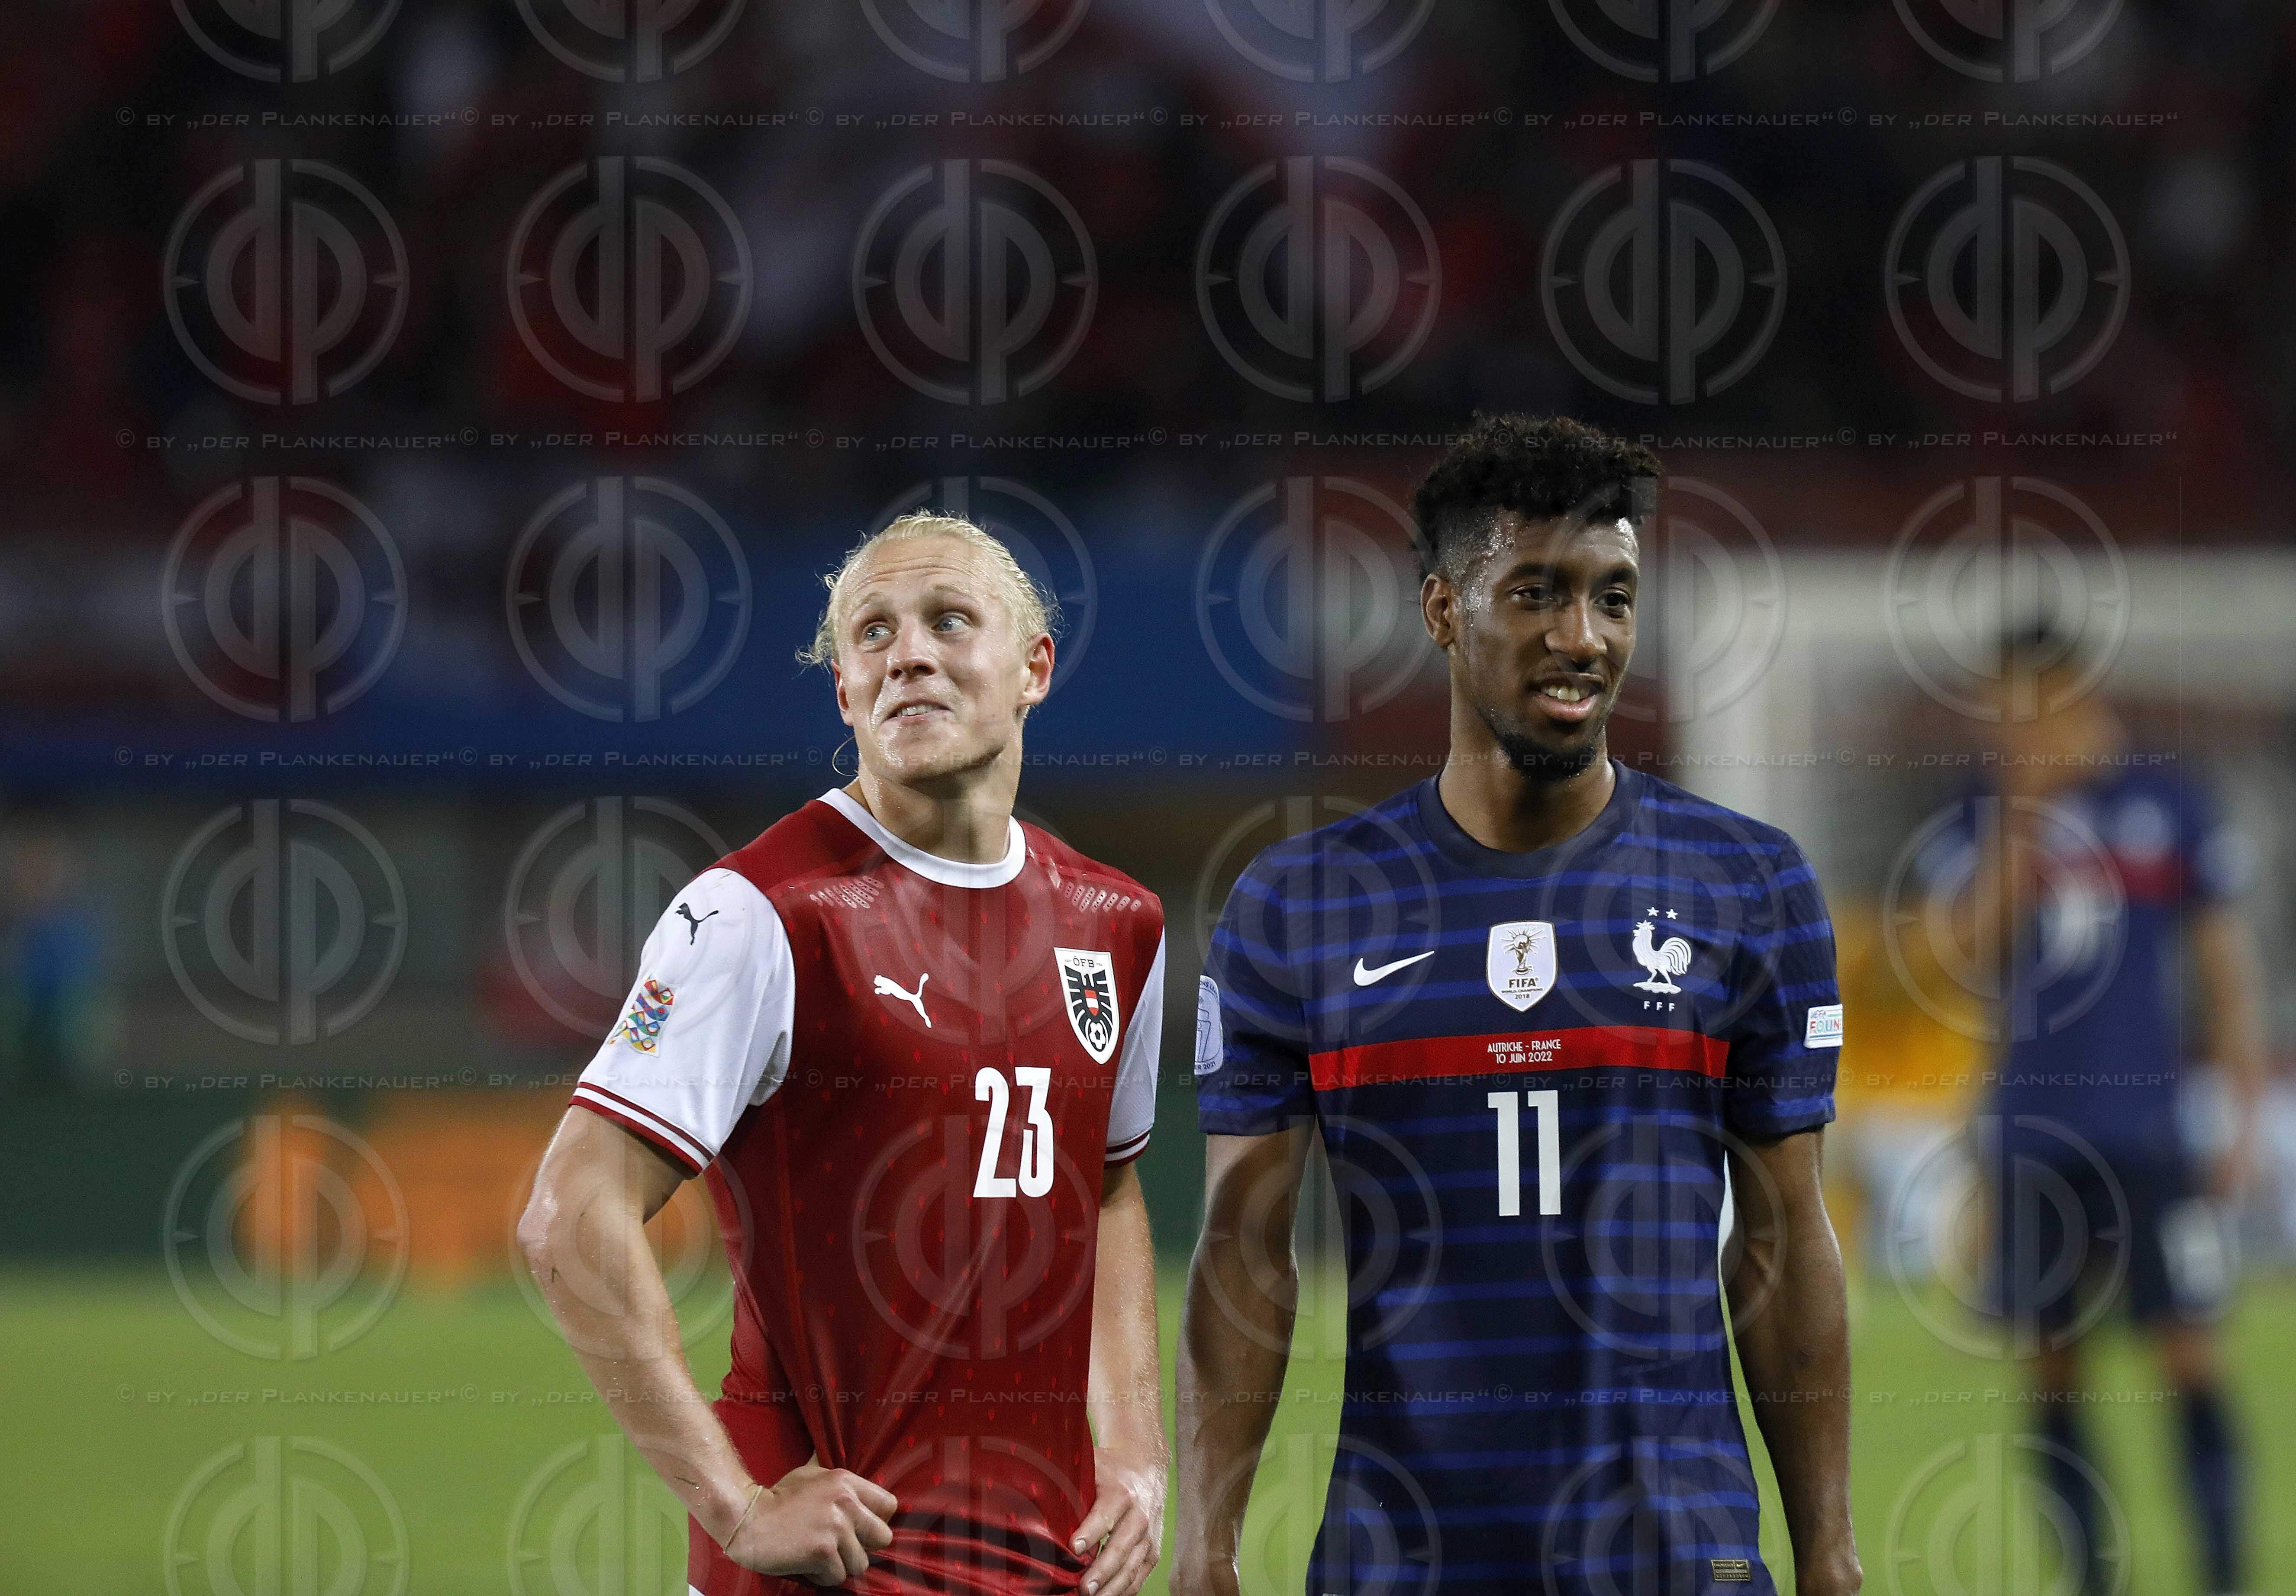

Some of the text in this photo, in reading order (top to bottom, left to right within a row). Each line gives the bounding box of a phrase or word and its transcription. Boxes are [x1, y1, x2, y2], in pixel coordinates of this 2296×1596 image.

[1073, 956, 1094, 968] ÖFB
[1487, 1041, 1523, 1053] AUTRICHE
[1531, 1039, 1561, 1051] FRANCE
[1496, 1051, 1553, 1064] 10 JUIN 2022
[1204, 1061, 1216, 1069] 2021
[973, 1066, 1055, 1198] 23
[1487, 1089, 1562, 1216] 11
